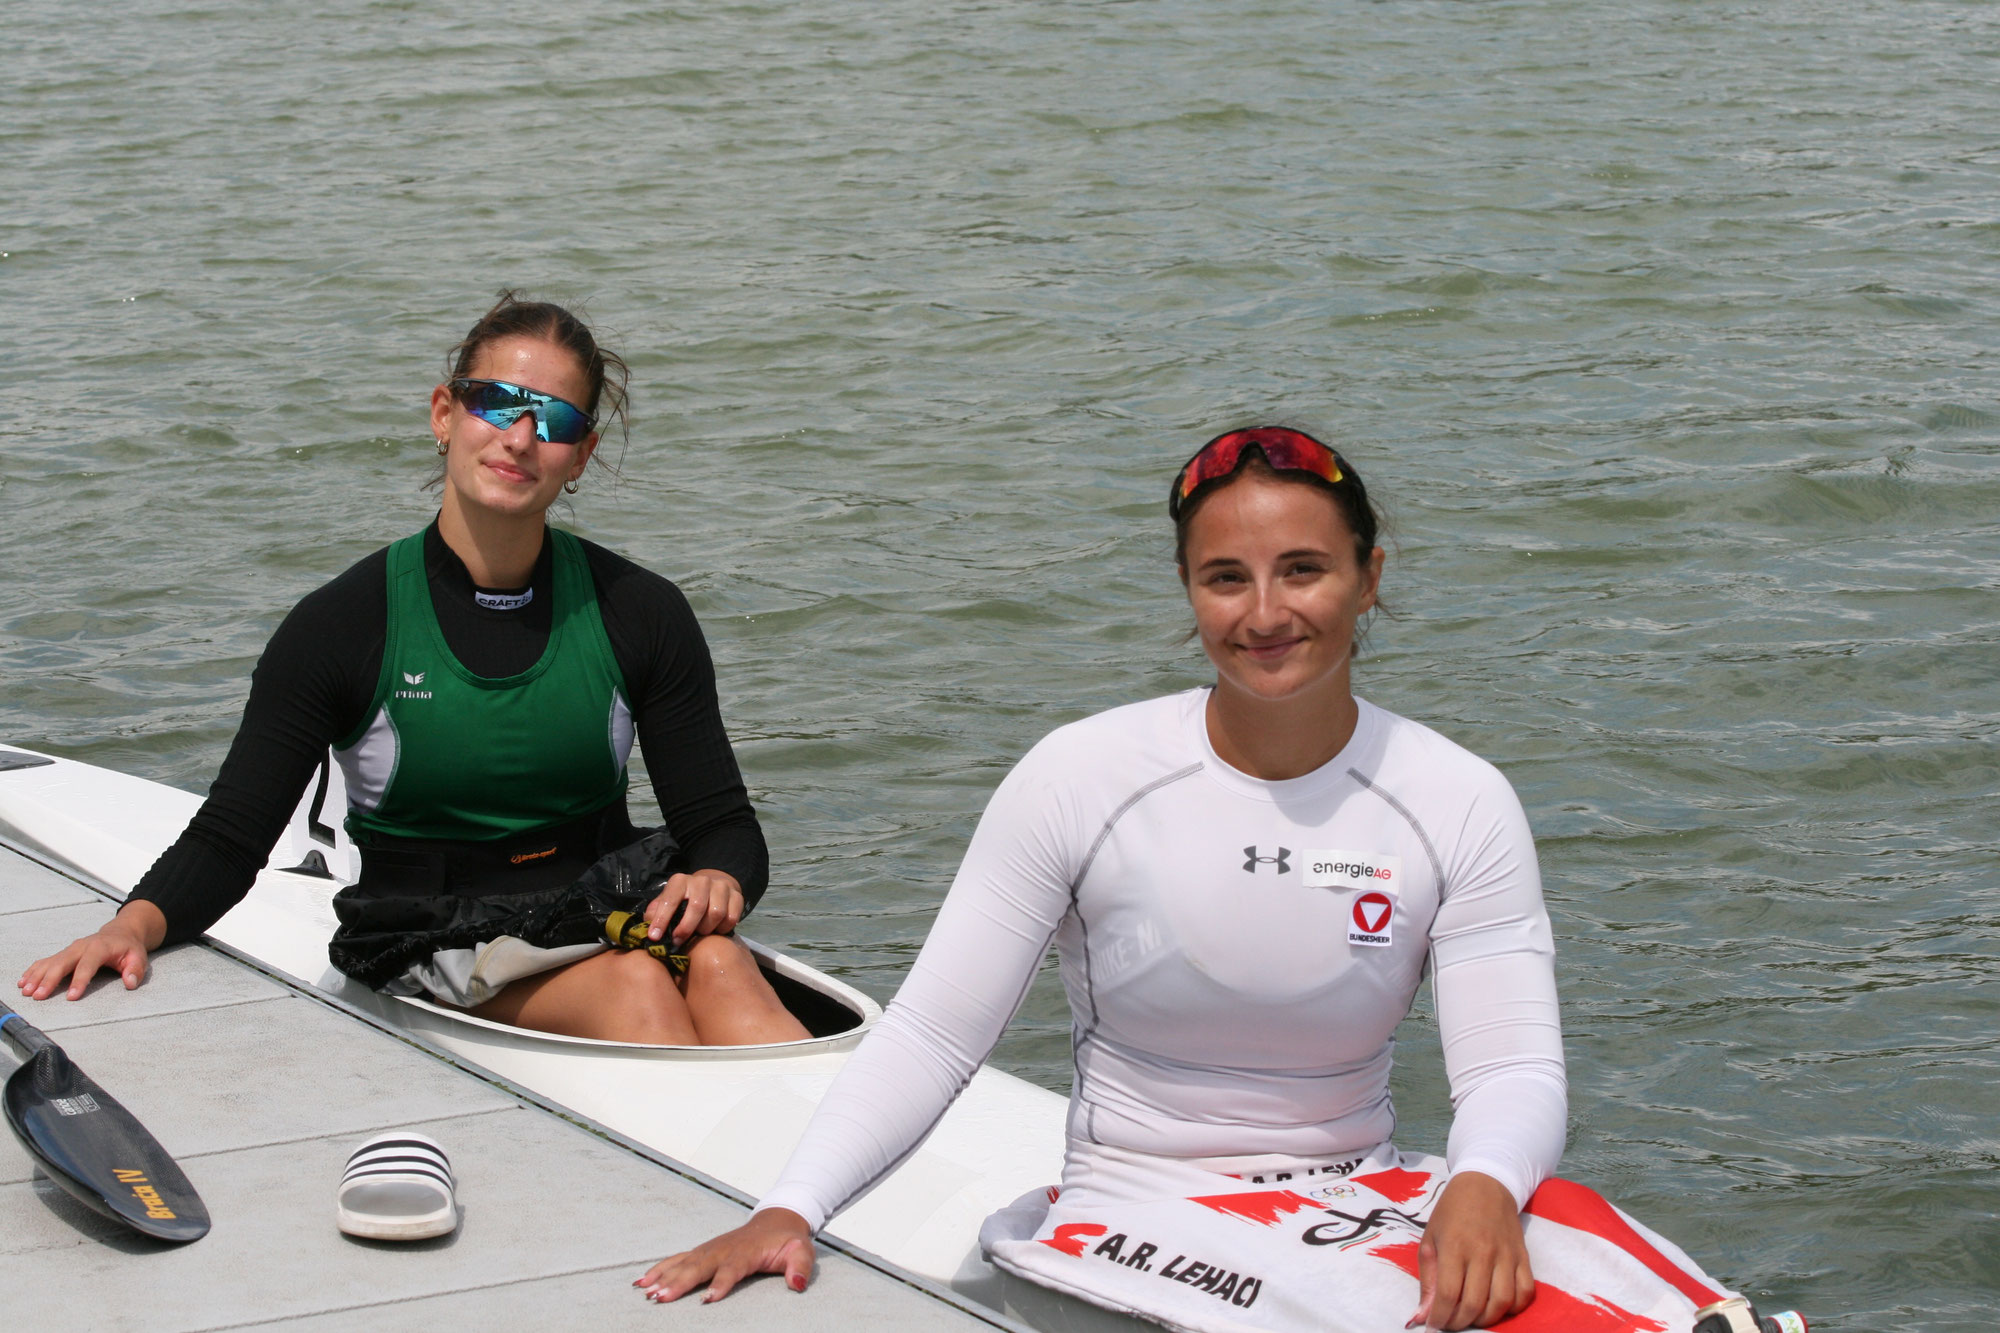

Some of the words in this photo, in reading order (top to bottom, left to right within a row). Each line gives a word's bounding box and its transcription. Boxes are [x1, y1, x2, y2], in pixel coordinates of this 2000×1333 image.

[479, 598, 521, 607] CRAFT
[1349, 933, 1390, 943] BUNDESHEER
[112, 1169, 149, 1183] IV
[1093, 1233, 1158, 1272] A.R.
[1158, 1255, 1263, 1309] LEHACI
